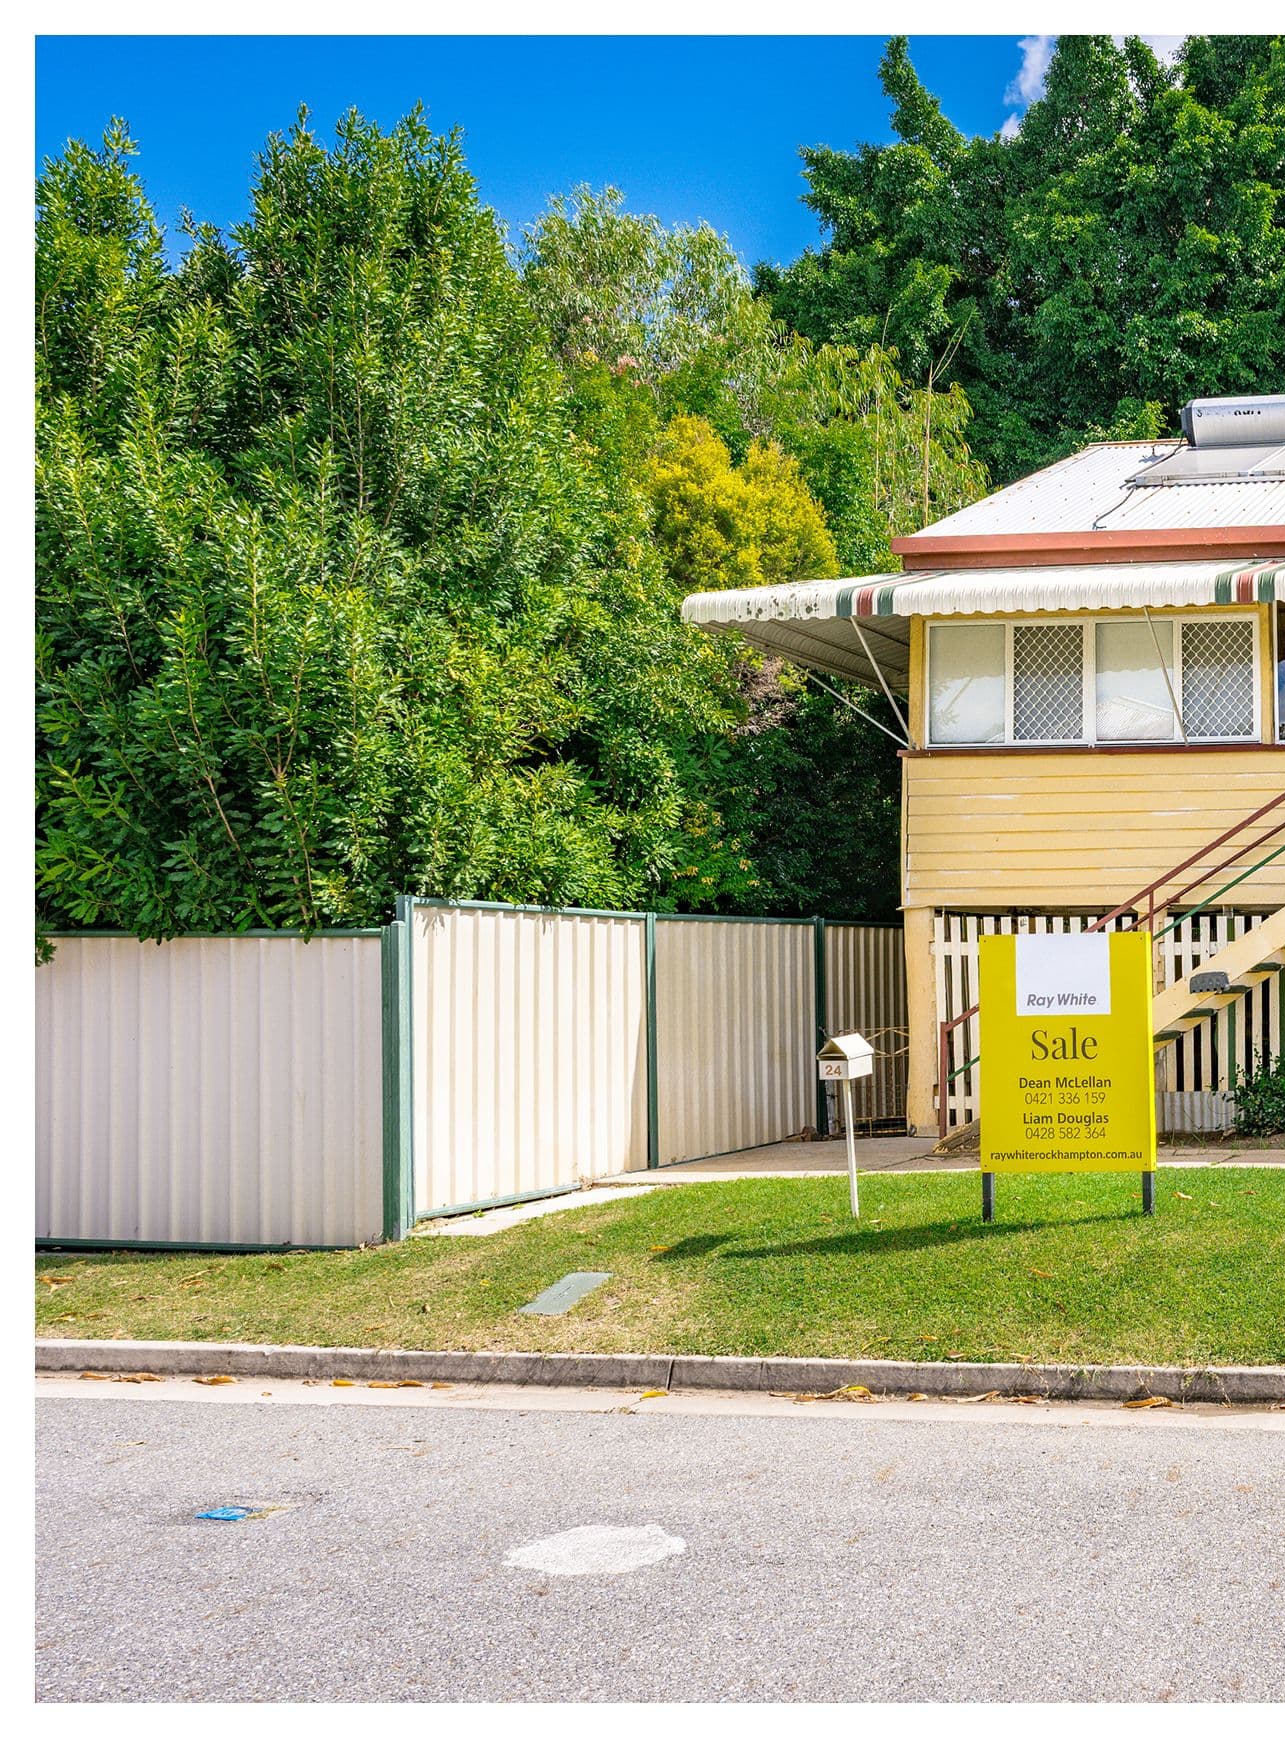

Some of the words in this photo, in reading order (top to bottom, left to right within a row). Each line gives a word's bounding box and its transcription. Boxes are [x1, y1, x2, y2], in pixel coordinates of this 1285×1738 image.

[1027, 994, 1054, 1008] Ray
[1057, 993, 1097, 1006] White
[1031, 1027, 1098, 1061] Sale
[825, 1065, 842, 1076] 24
[1019, 1077, 1051, 1088] Dean
[1055, 1076, 1112, 1088] McLellan
[1024, 1092, 1053, 1105] 0421
[1058, 1092, 1081, 1105] 336
[1085, 1092, 1106, 1105] 159
[1023, 1112, 1053, 1124] Liam
[1057, 1112, 1109, 1127] Douglas
[1025, 1127, 1055, 1140] 0428
[1059, 1127, 1082, 1140] 582
[1084, 1127, 1106, 1140] 364
[990, 1149, 1143, 1161] raywhiterockhampton.com.au
